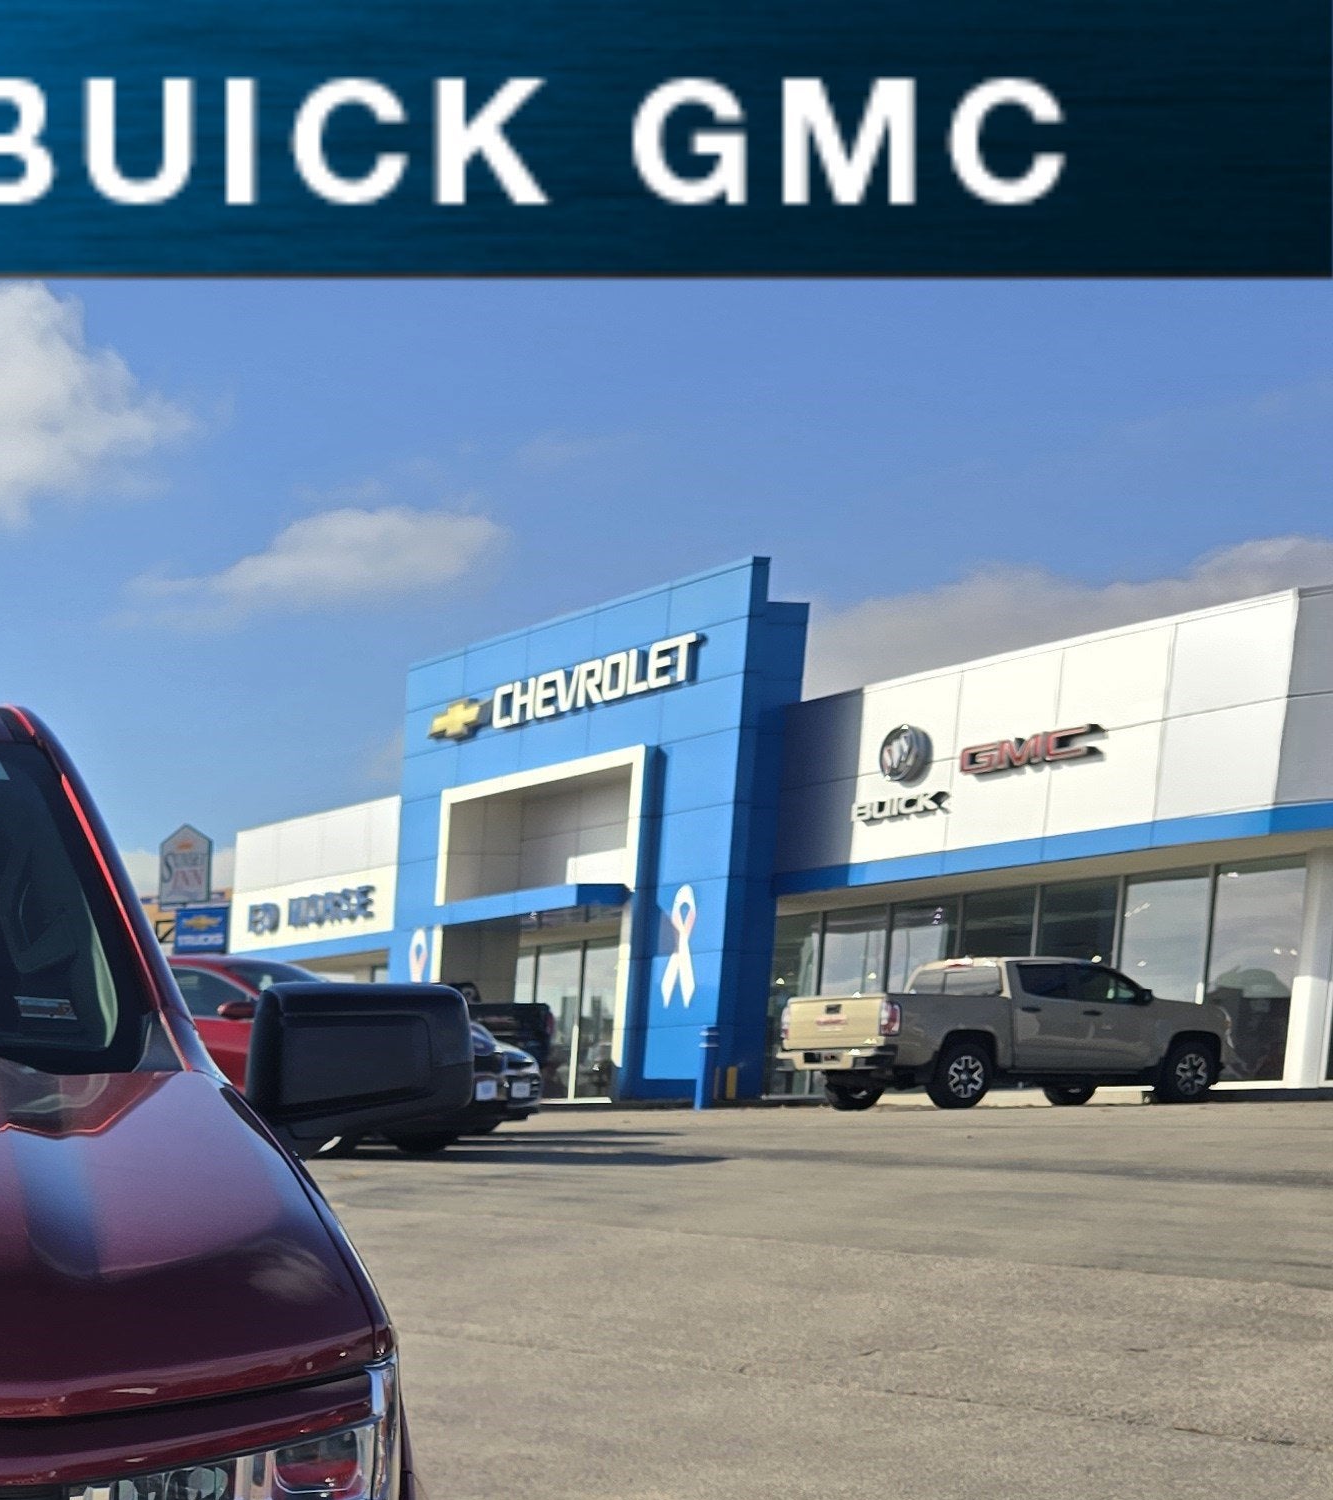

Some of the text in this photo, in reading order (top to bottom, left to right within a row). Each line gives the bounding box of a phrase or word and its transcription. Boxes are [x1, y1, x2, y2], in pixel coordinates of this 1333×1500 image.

[491, 631, 701, 730] CHEVROLET
[959, 724, 1103, 776] GMC
[852, 790, 945, 823] BUICK
[247, 884, 377, 936] ED MORSE
